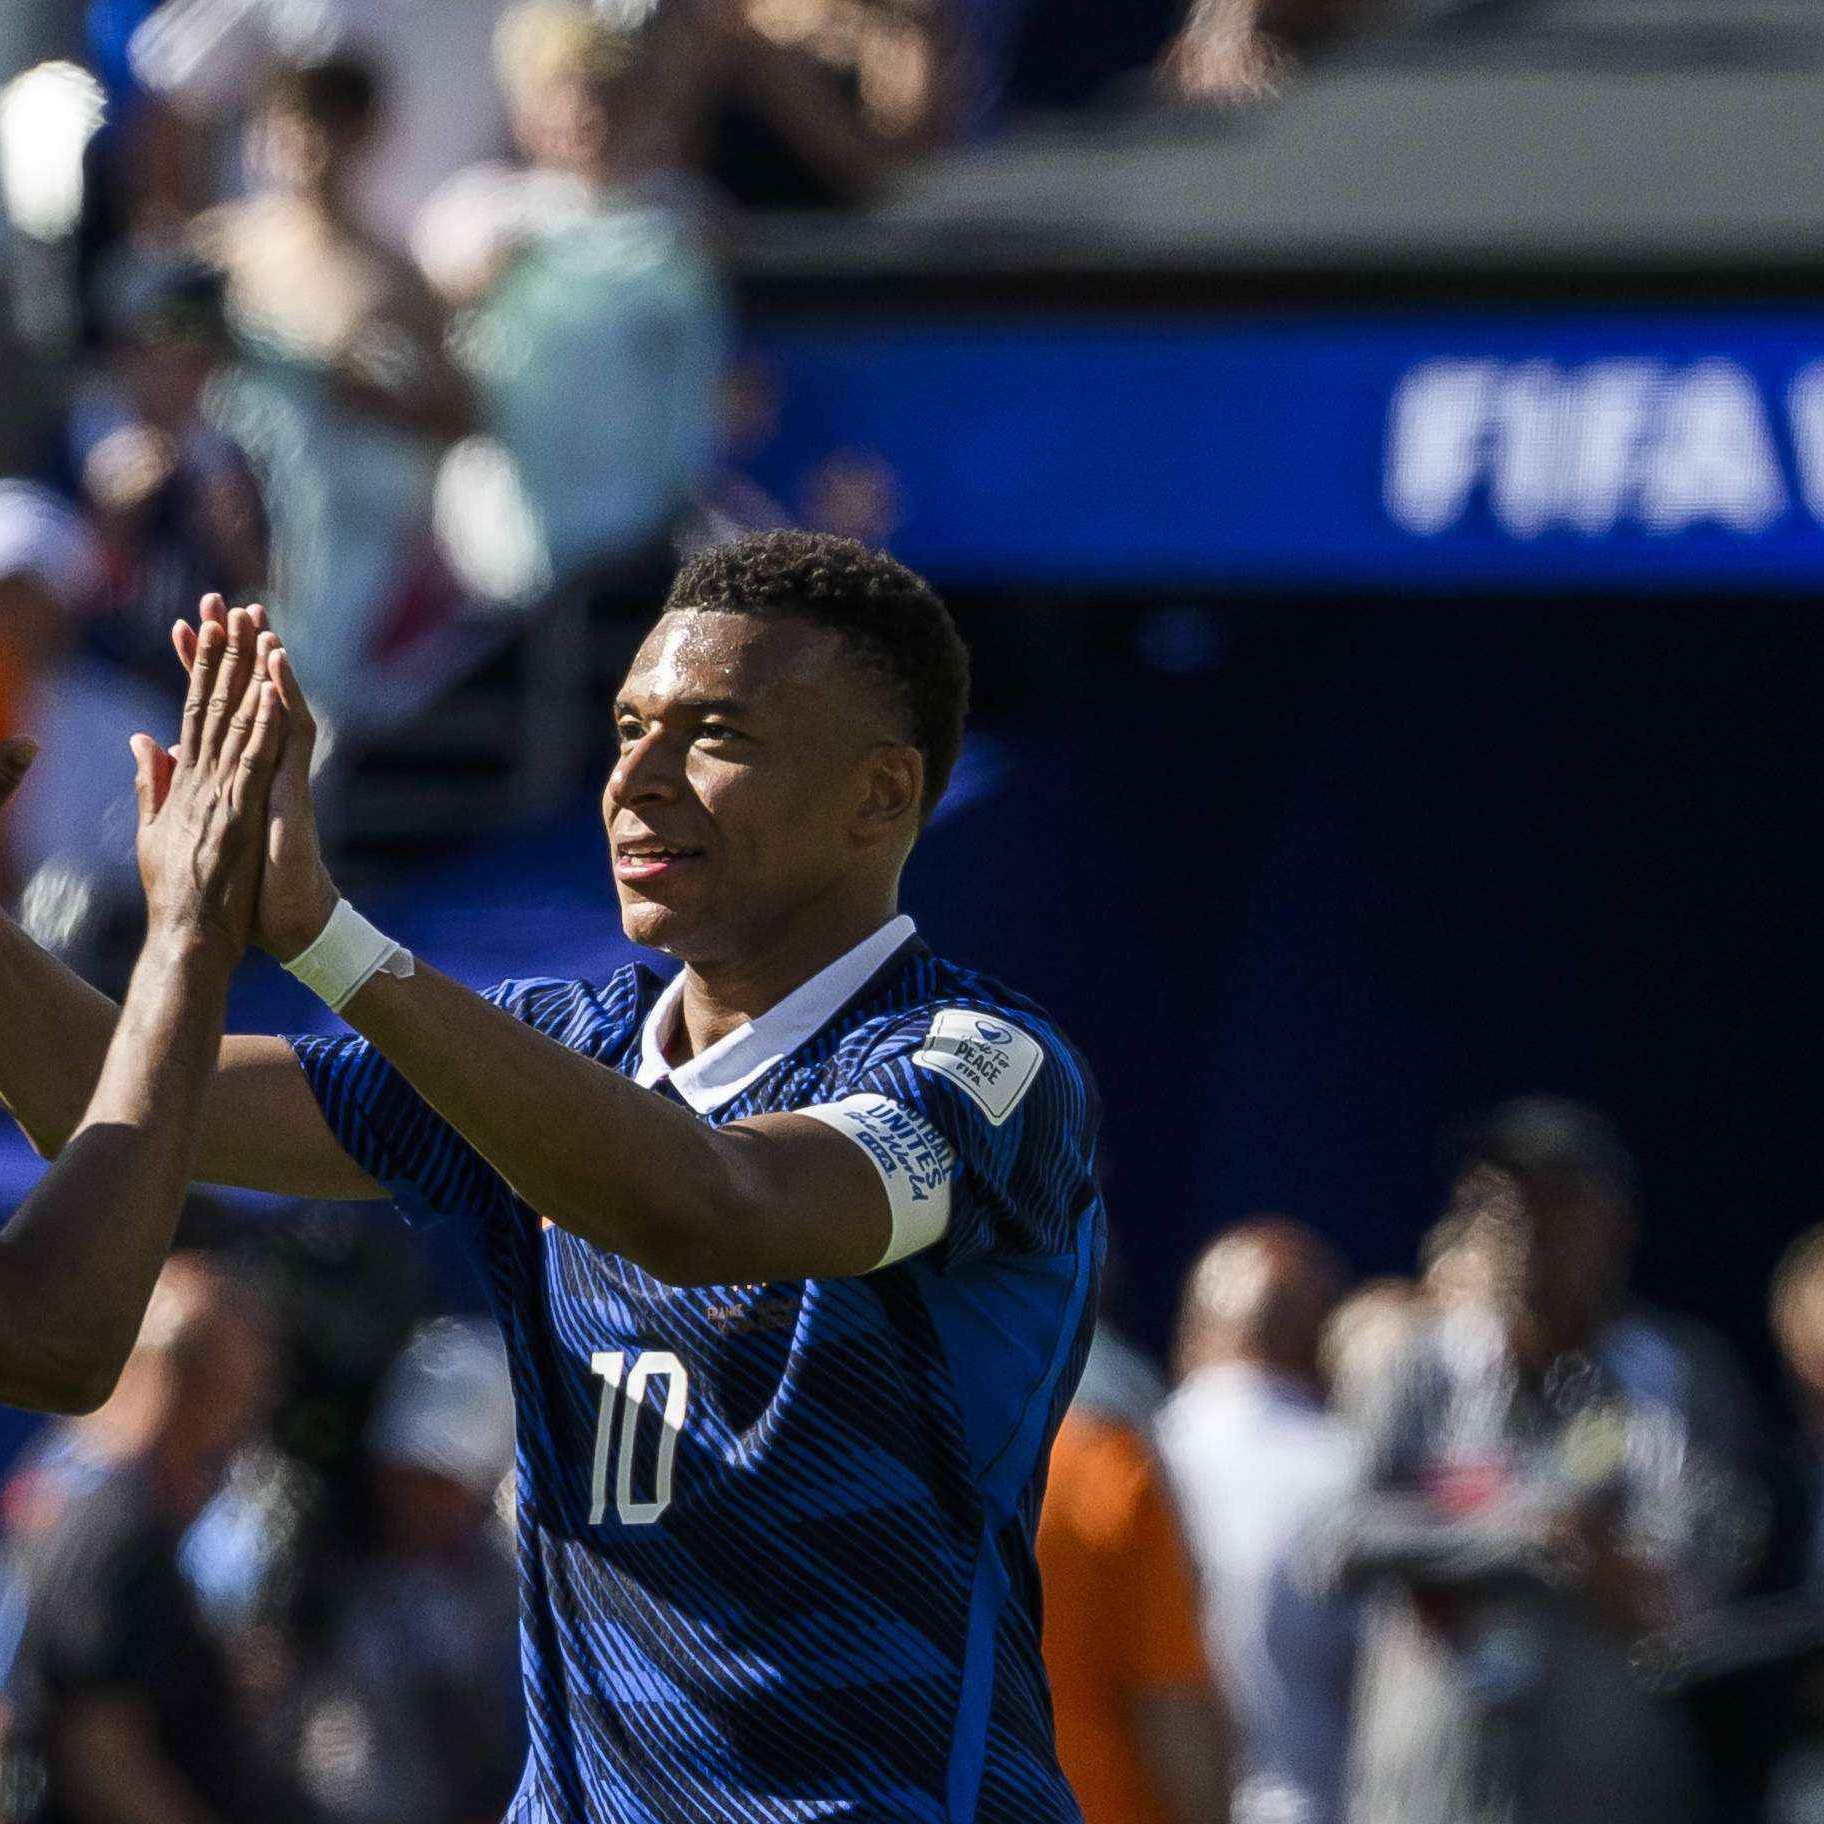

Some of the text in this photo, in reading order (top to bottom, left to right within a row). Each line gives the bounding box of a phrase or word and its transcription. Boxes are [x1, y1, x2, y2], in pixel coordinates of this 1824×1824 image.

[1387, 362, 1781, 530] FIFA
[954, 1040, 1002, 1085] PEACE
[866, 1104, 942, 1189] UNITES
[880, 1134, 929, 1201] World
[587, 1350, 689, 1525] 10
